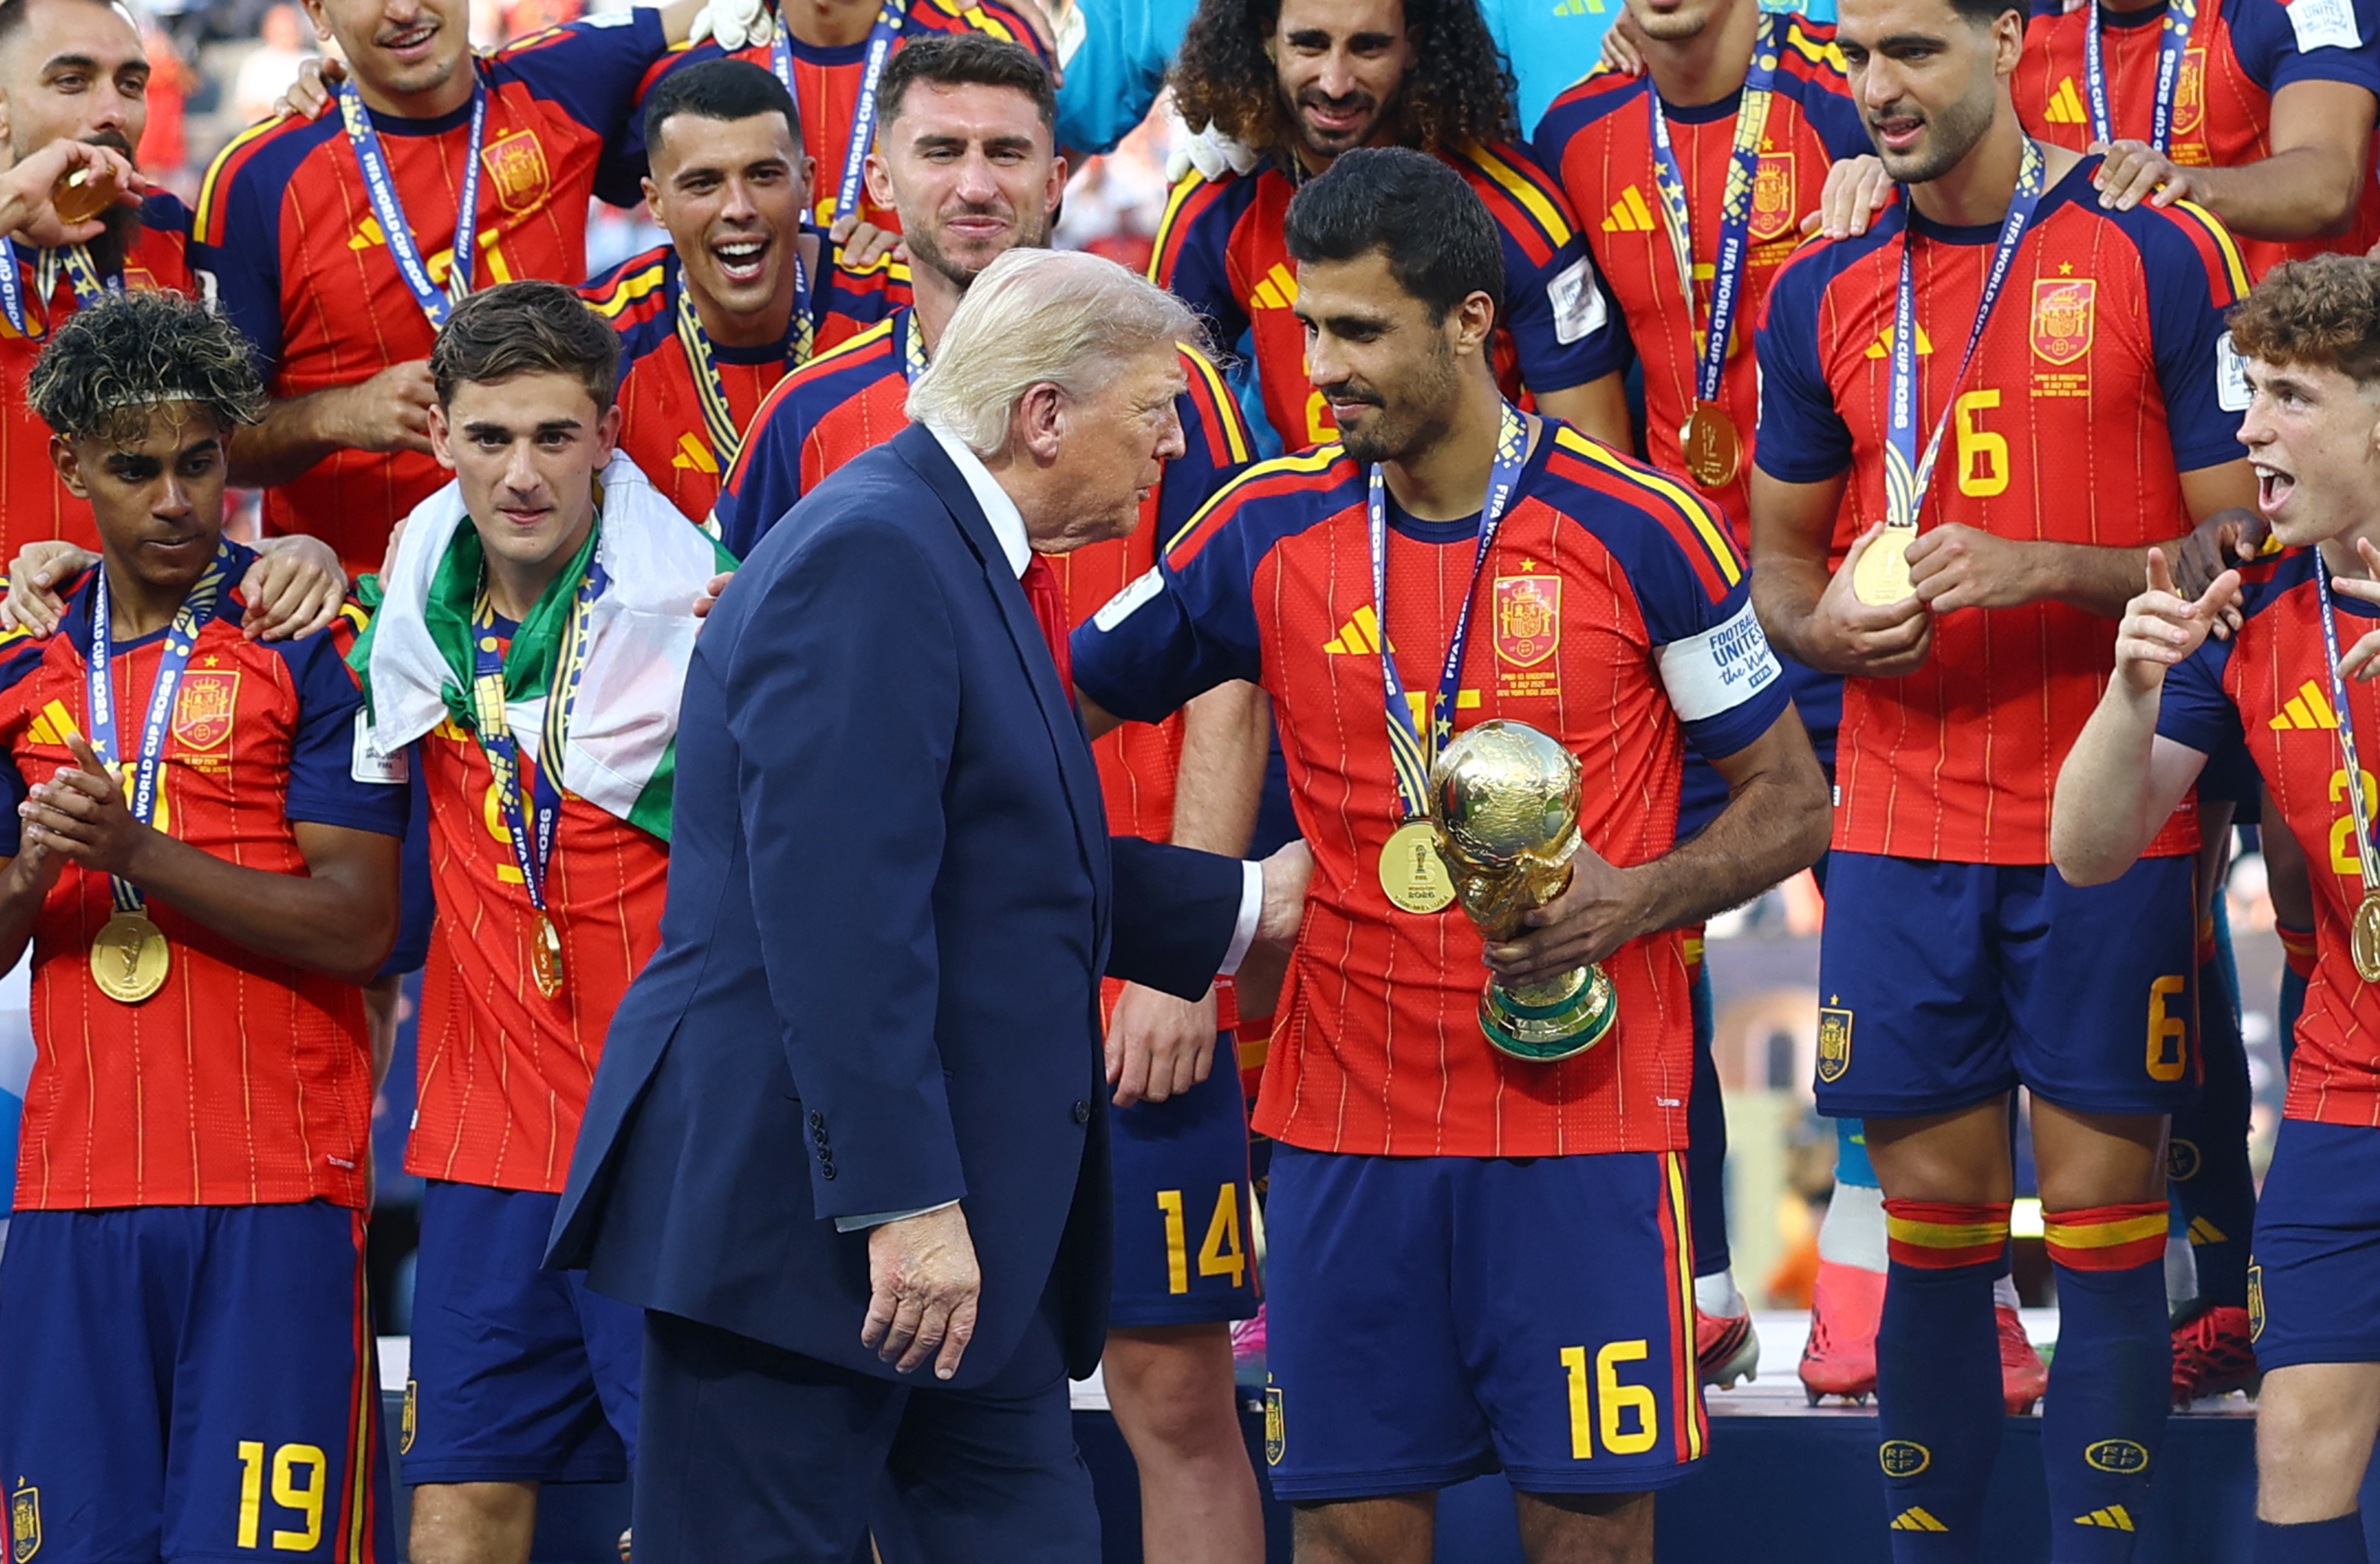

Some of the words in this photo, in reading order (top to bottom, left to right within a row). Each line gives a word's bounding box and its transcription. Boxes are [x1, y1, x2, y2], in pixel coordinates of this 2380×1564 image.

[865, 39, 887, 91] 2026
[2089, 29, 2100, 86] WORLD
[2157, 49, 2176, 104] 2026
[859, 91, 874, 121] CUP
[2092, 87, 2105, 118] CUP
[2154, 106, 2166, 138] CUP
[847, 122, 868, 176] WORLD
[461, 177, 475, 228] WORLD
[468, 149, 478, 177] CUP
[840, 175, 857, 210] FIFA
[363, 152, 382, 183] FIFA
[373, 180, 401, 232] WORLD
[392, 232, 412, 259] CUP
[402, 259, 434, 296] 2026
[2003, 212, 2025, 245] FIFA
[1722, 238, 1739, 272] FIFA
[1984, 248, 2011, 303] WORLD
[1714, 274, 1733, 331] WORLD
[1899, 286, 1909, 341] WORLD
[1974, 303, 1989, 335] CUP
[1710, 332, 1723, 365] CUP
[1897, 342, 1909, 374] CUP
[1894, 374, 1909, 429] 2026
[1955, 389, 2009, 497] 6
[1490, 484, 1509, 519] FIFA
[1372, 505, 1381, 563] 2026
[1713, 623, 1764, 667] UNITES
[2322, 603, 2333, 635] CUP
[93, 641, 105, 669] CUP
[1446, 642, 1460, 678] FIFA
[1718, 667, 1745, 686] the
[93, 670, 109, 725] 2026
[151, 670, 176, 724] 2026
[144, 725, 159, 757] CUP
[135, 758, 153, 818] WORLD
[513, 827, 528, 861] FIFA
[539, 808, 552, 864] 2026
[2146, 975, 2187, 1082] 6
[1157, 1182, 1244, 1294] 14
[1560, 1339, 1658, 1459] 16
[237, 1440, 326, 1552] 19
